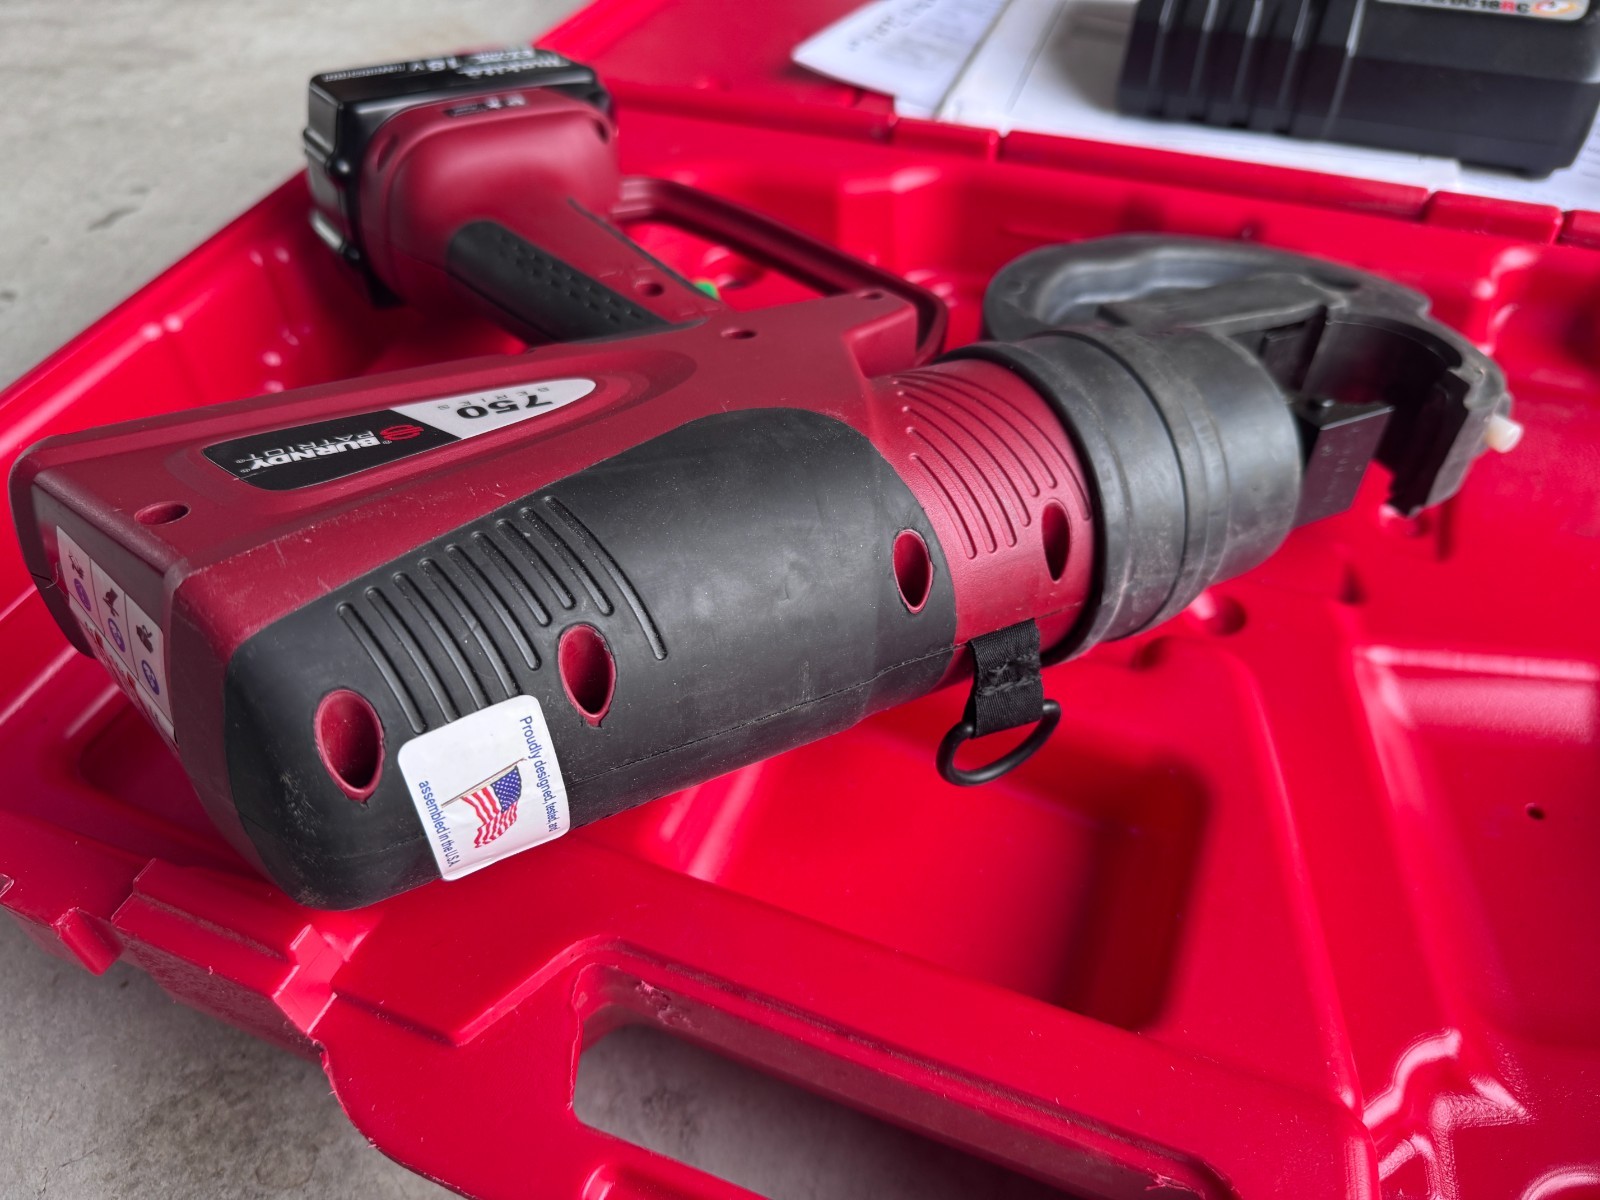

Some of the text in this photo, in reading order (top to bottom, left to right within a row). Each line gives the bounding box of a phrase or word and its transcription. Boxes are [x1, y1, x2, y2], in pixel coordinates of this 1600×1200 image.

[437, 386, 550, 411] SERIES
[456, 394, 554, 419] 750
[519, 715, 543, 760] Proudly
[534, 761, 557, 805] designed,
[418, 780, 450, 834] assembled
[545, 802, 560, 825] tested,
[438, 831, 452, 843] in
[441, 840, 455, 853] the
